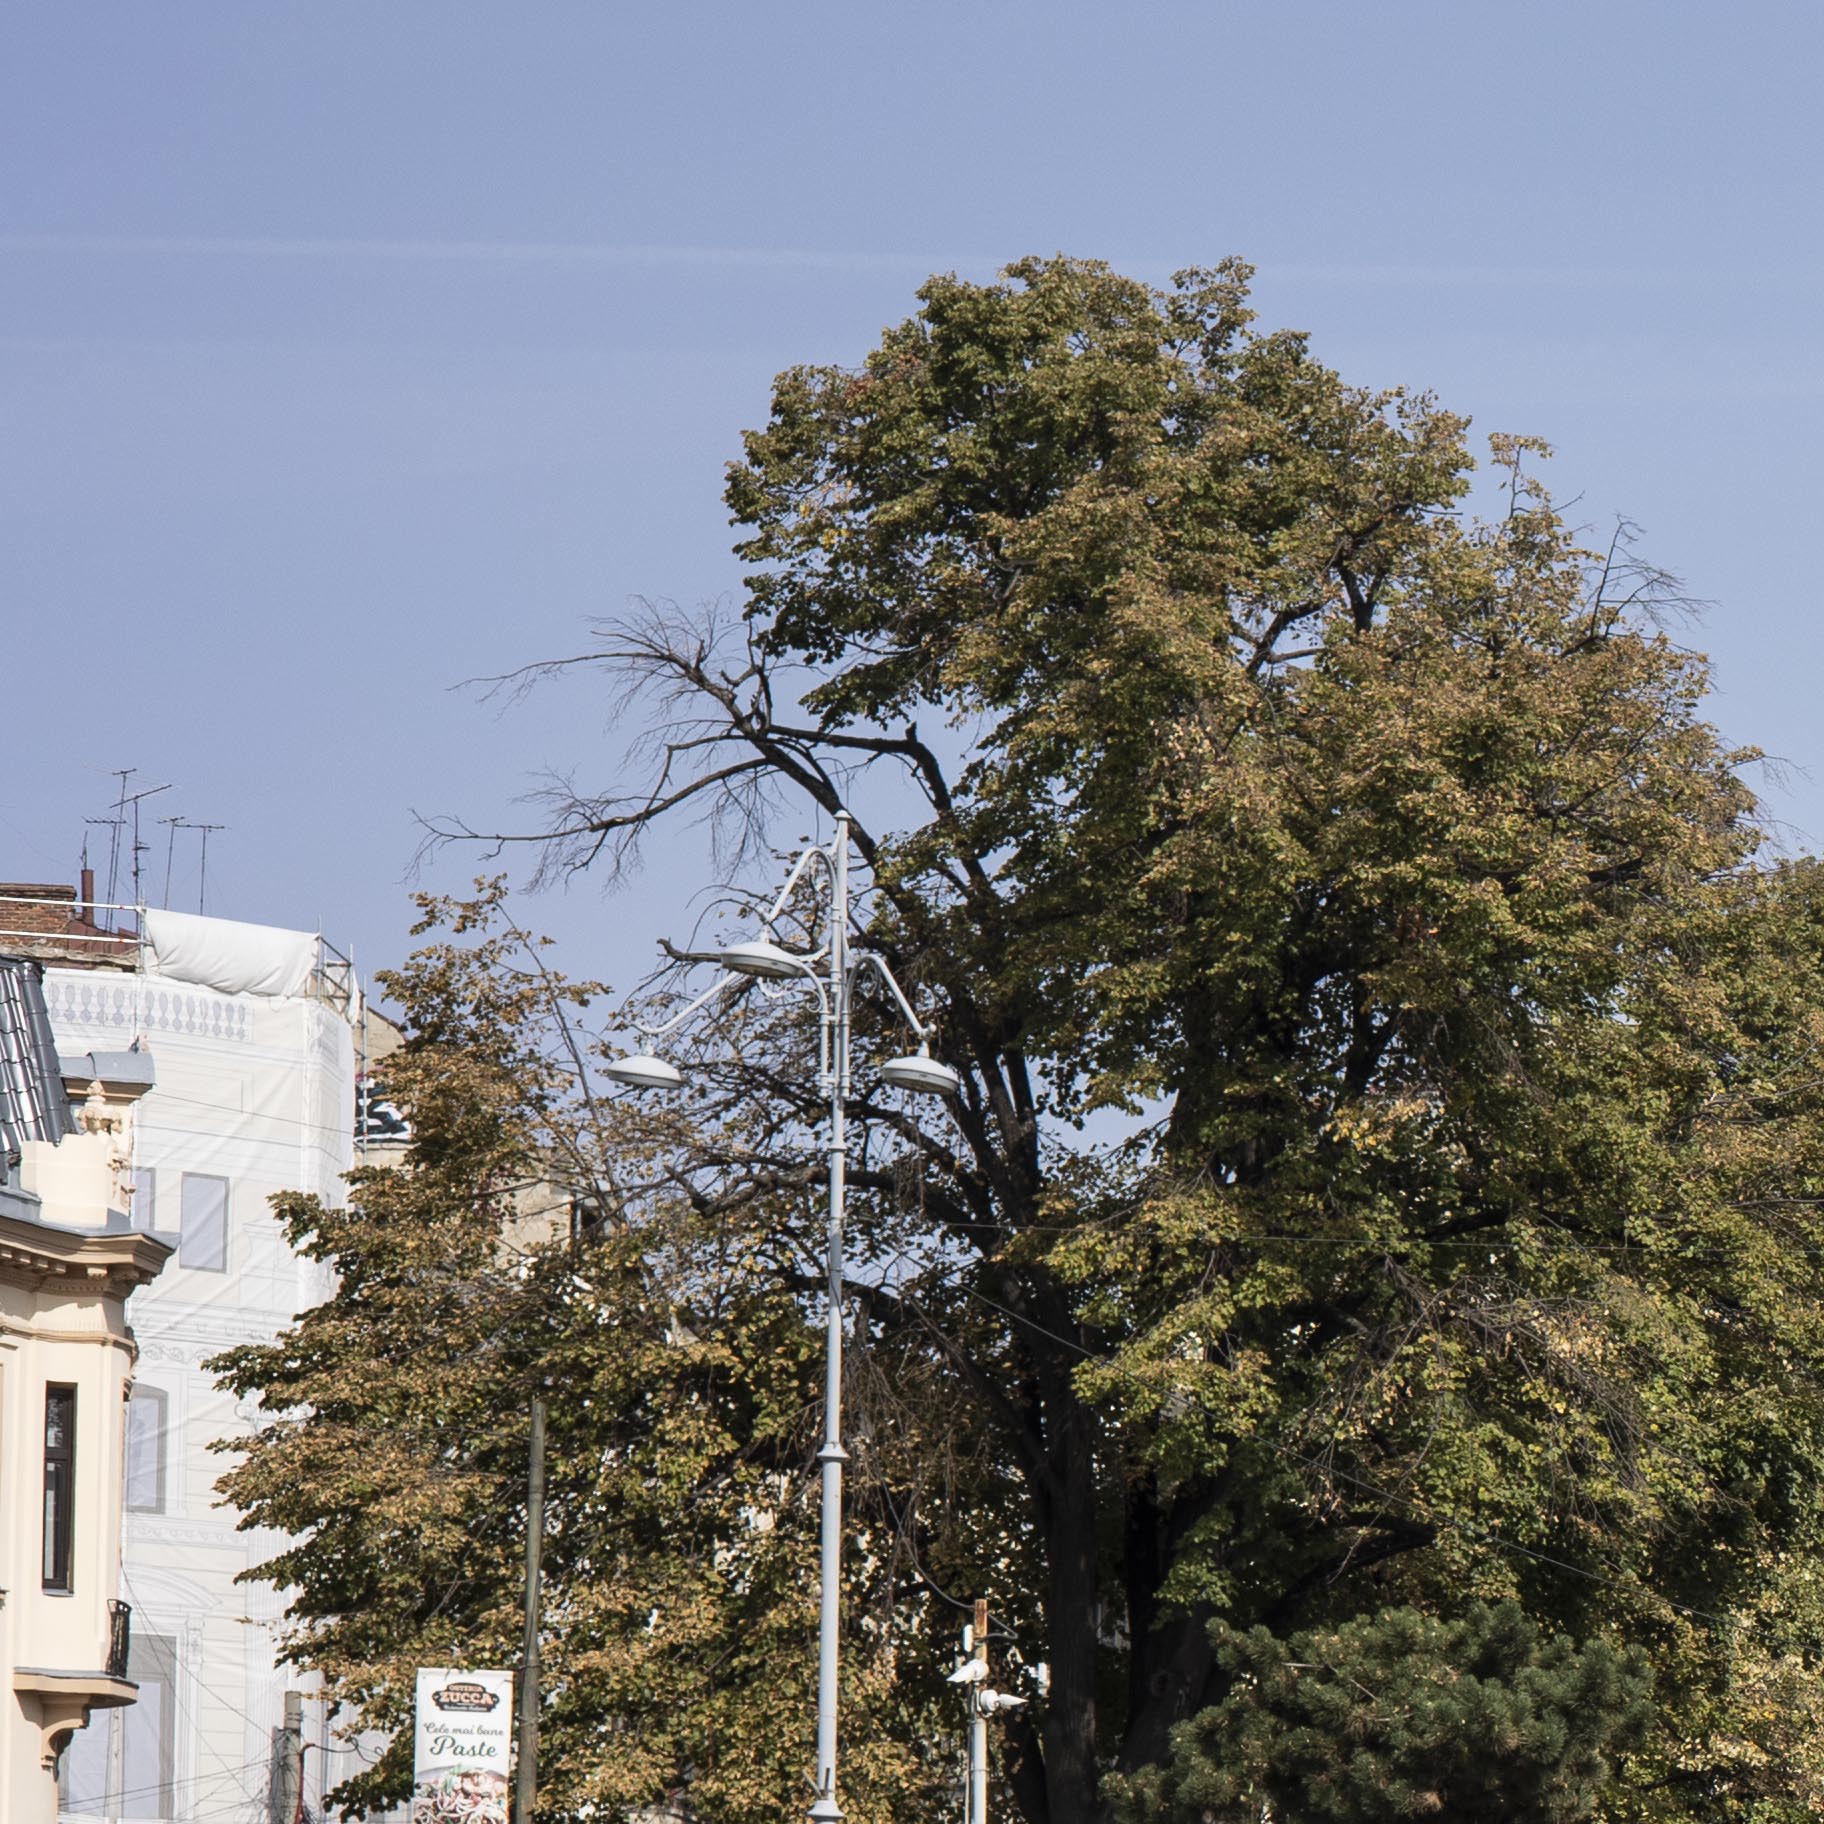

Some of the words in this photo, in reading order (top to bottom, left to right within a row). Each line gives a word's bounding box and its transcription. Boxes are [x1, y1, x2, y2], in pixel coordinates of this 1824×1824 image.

[439, 1691, 494, 1706] ZUCCA
[452, 1724, 474, 1736] mai
[430, 1735, 498, 1757] Paste
